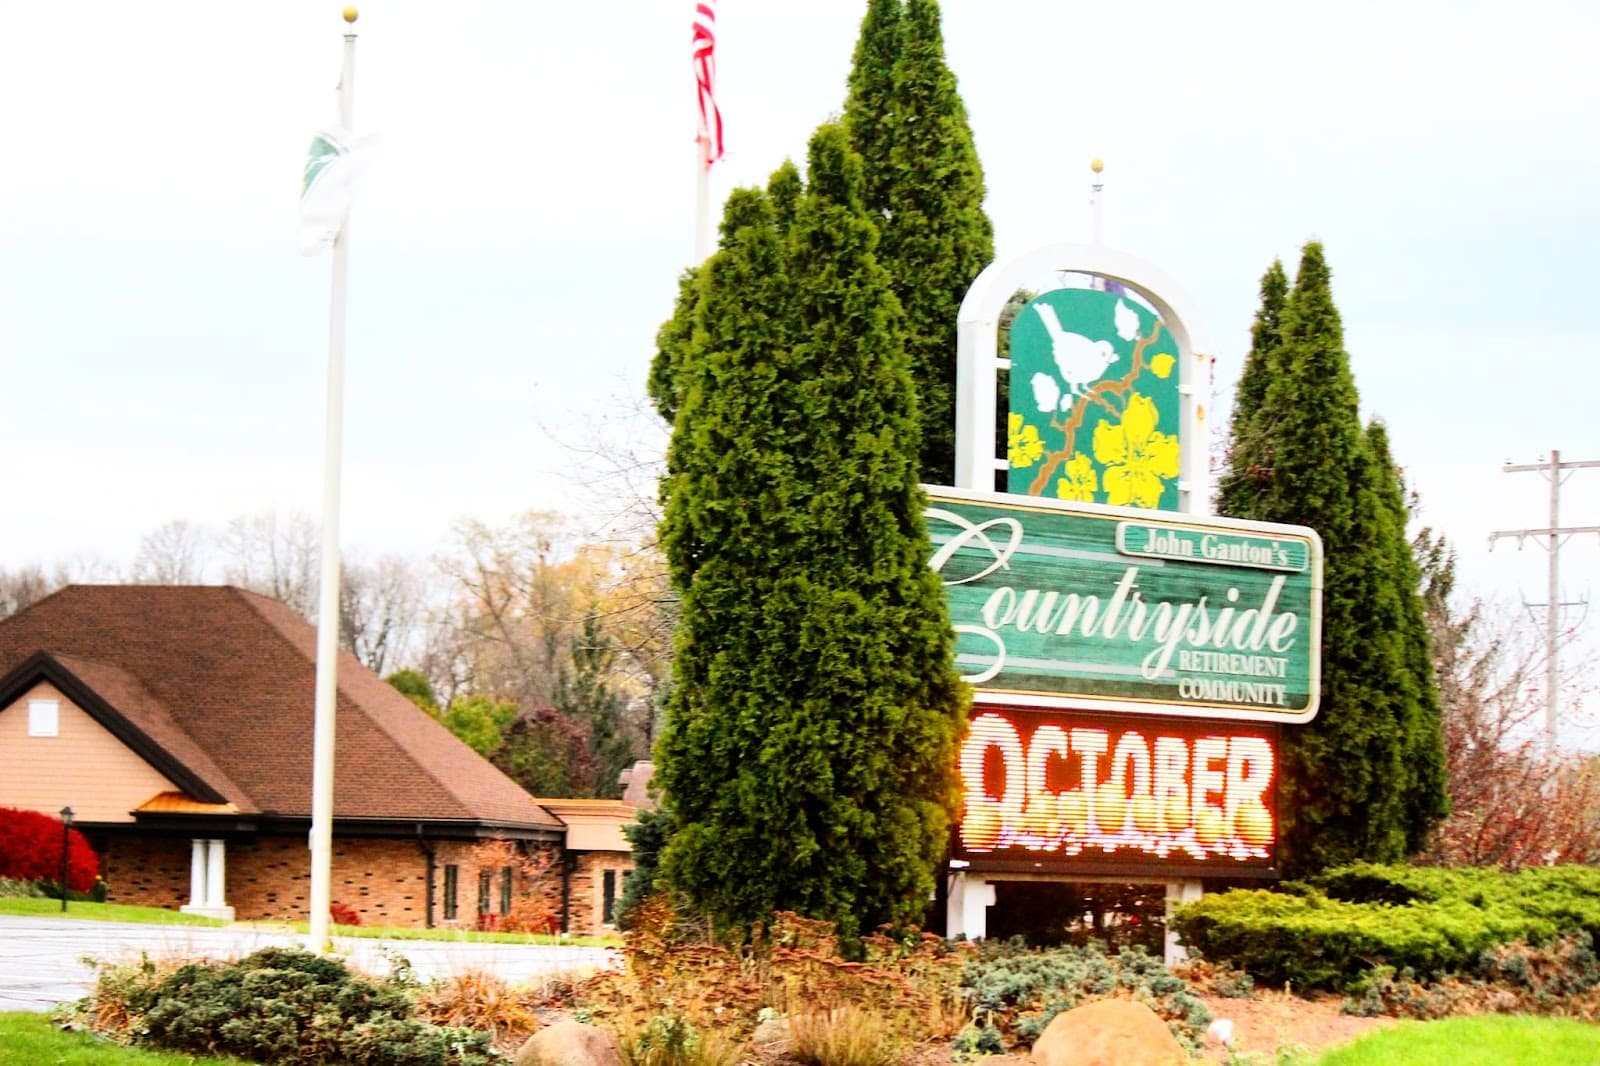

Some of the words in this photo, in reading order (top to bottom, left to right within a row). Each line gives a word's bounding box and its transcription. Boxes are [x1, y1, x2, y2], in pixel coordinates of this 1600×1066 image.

[1143, 528, 1194, 557] John
[1200, 534, 1289, 566] Ganton's
[1178, 650, 1289, 678] RETIREMENT
[1178, 677, 1287, 705] COMMUNITY
[959, 712, 1275, 852] OCTOBER
